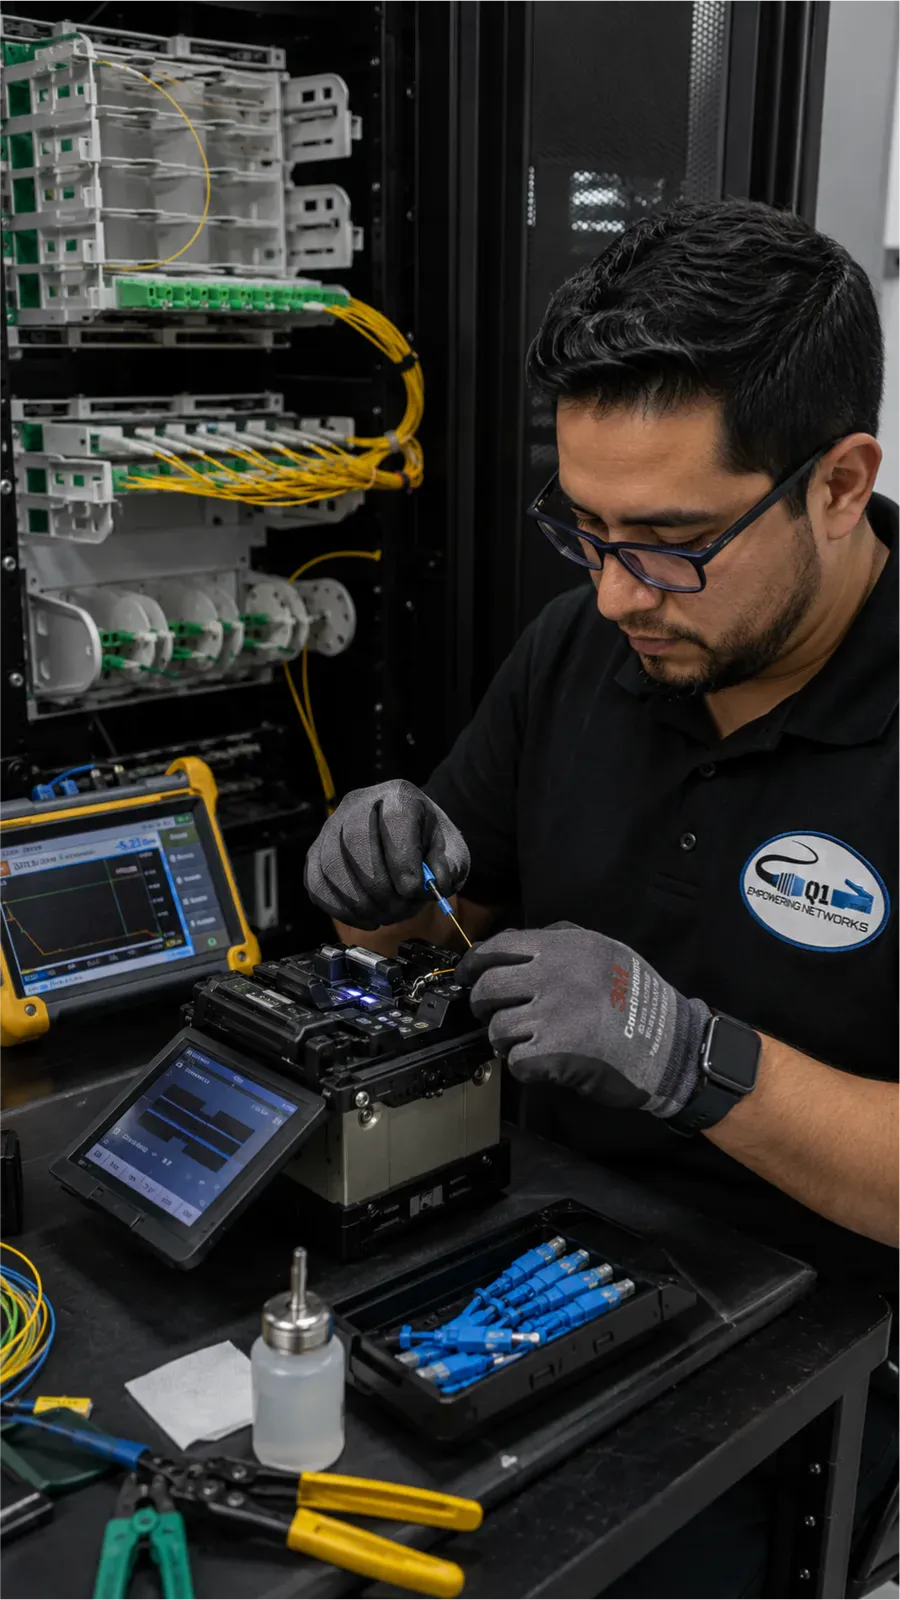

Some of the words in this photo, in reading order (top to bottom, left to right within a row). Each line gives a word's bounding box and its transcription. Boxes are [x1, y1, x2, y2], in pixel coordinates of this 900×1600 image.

[746, 886, 802, 911] EMPOWERING
[801, 904, 869, 933] NETWORKS
[804, 880, 830, 905] Q1
